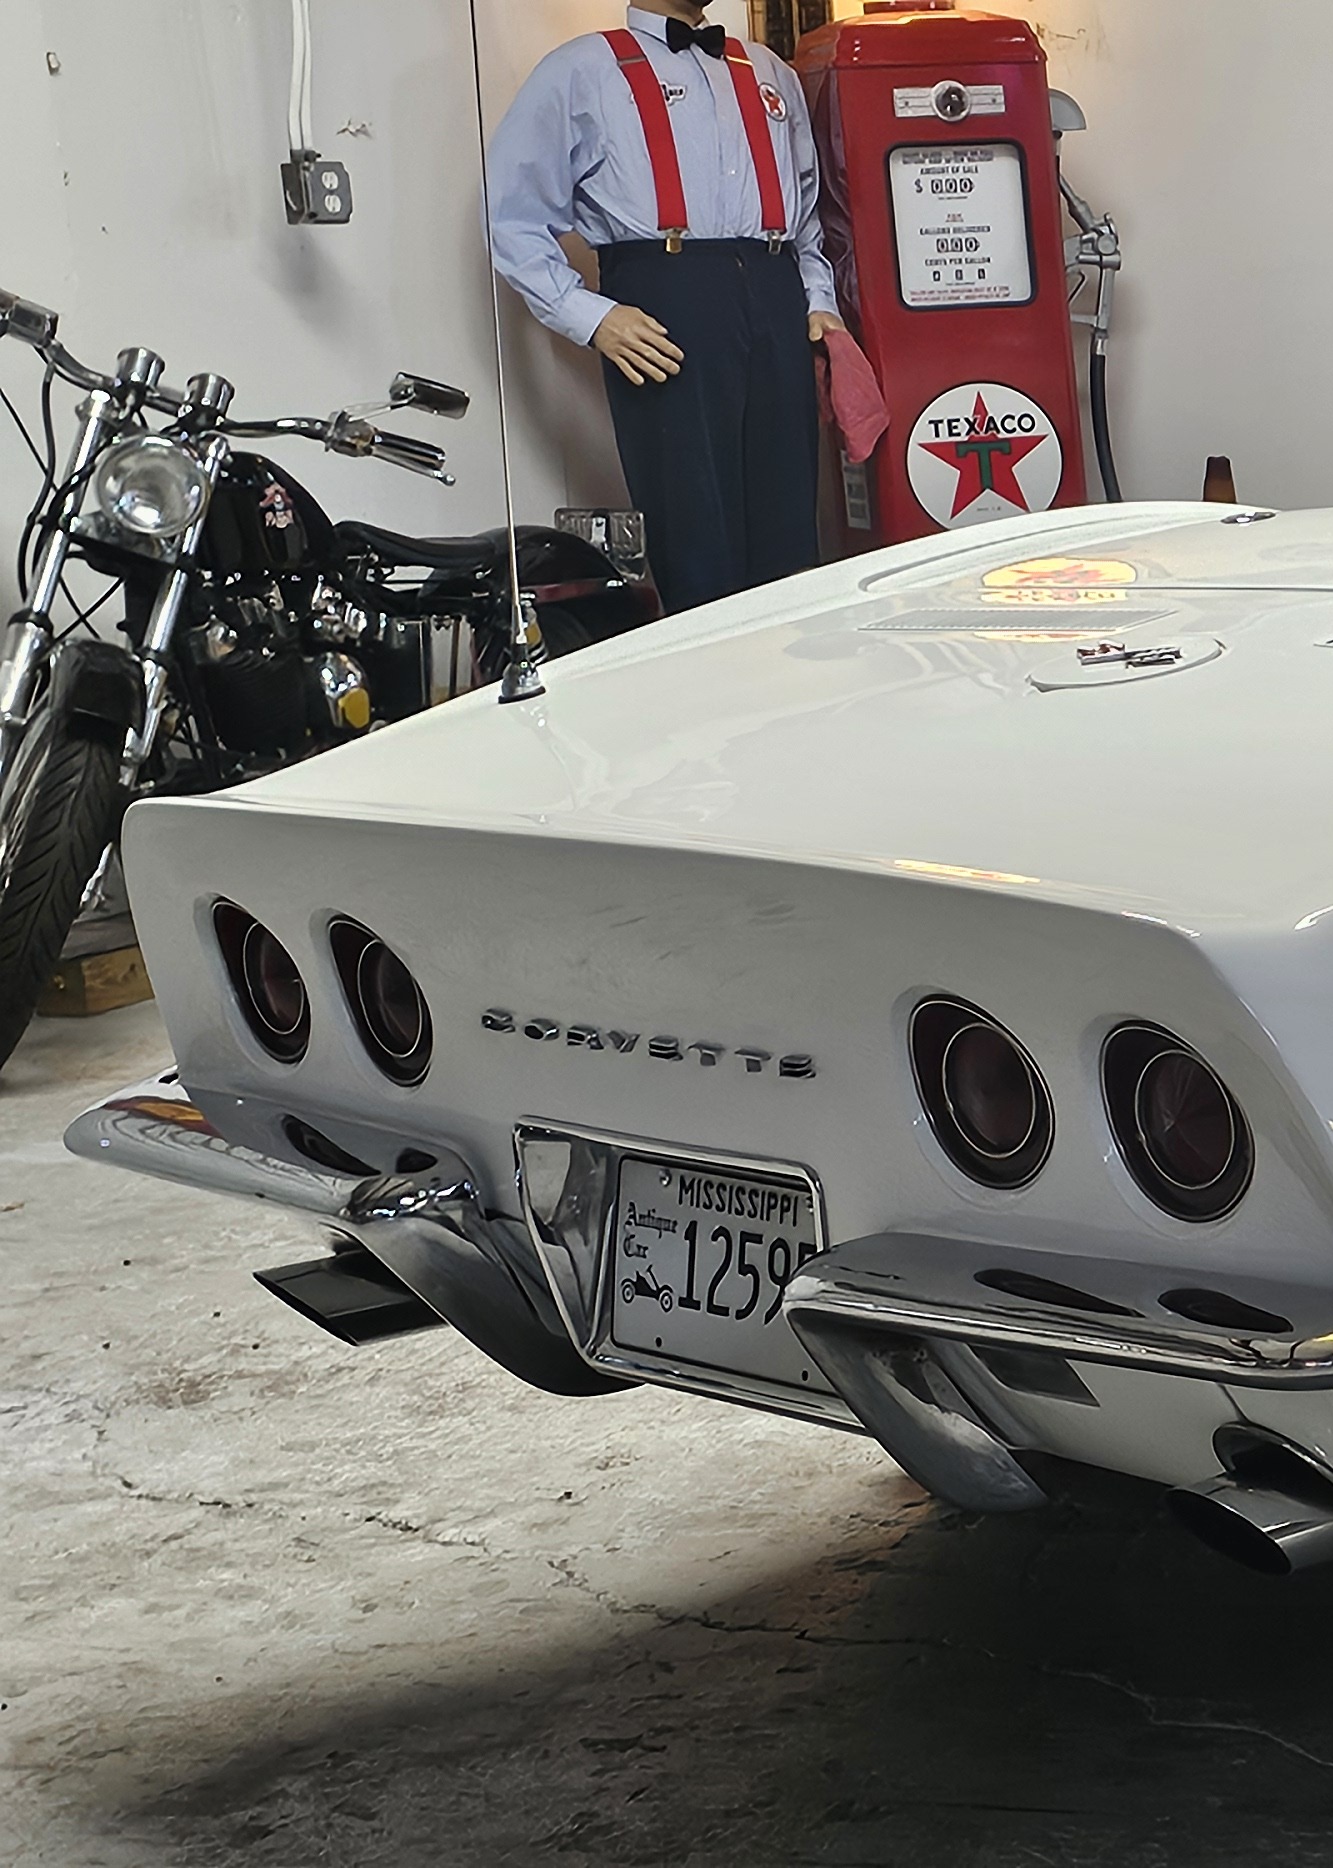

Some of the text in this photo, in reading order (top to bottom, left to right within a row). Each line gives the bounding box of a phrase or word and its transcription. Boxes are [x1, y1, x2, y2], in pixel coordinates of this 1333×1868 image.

[927, 412, 1037, 439] TEXACO
[481, 1008, 817, 1080] CORVETTE
[677, 1174, 799, 1228] MISSISSIPPI
[623, 1233, 649, 1259] Car
